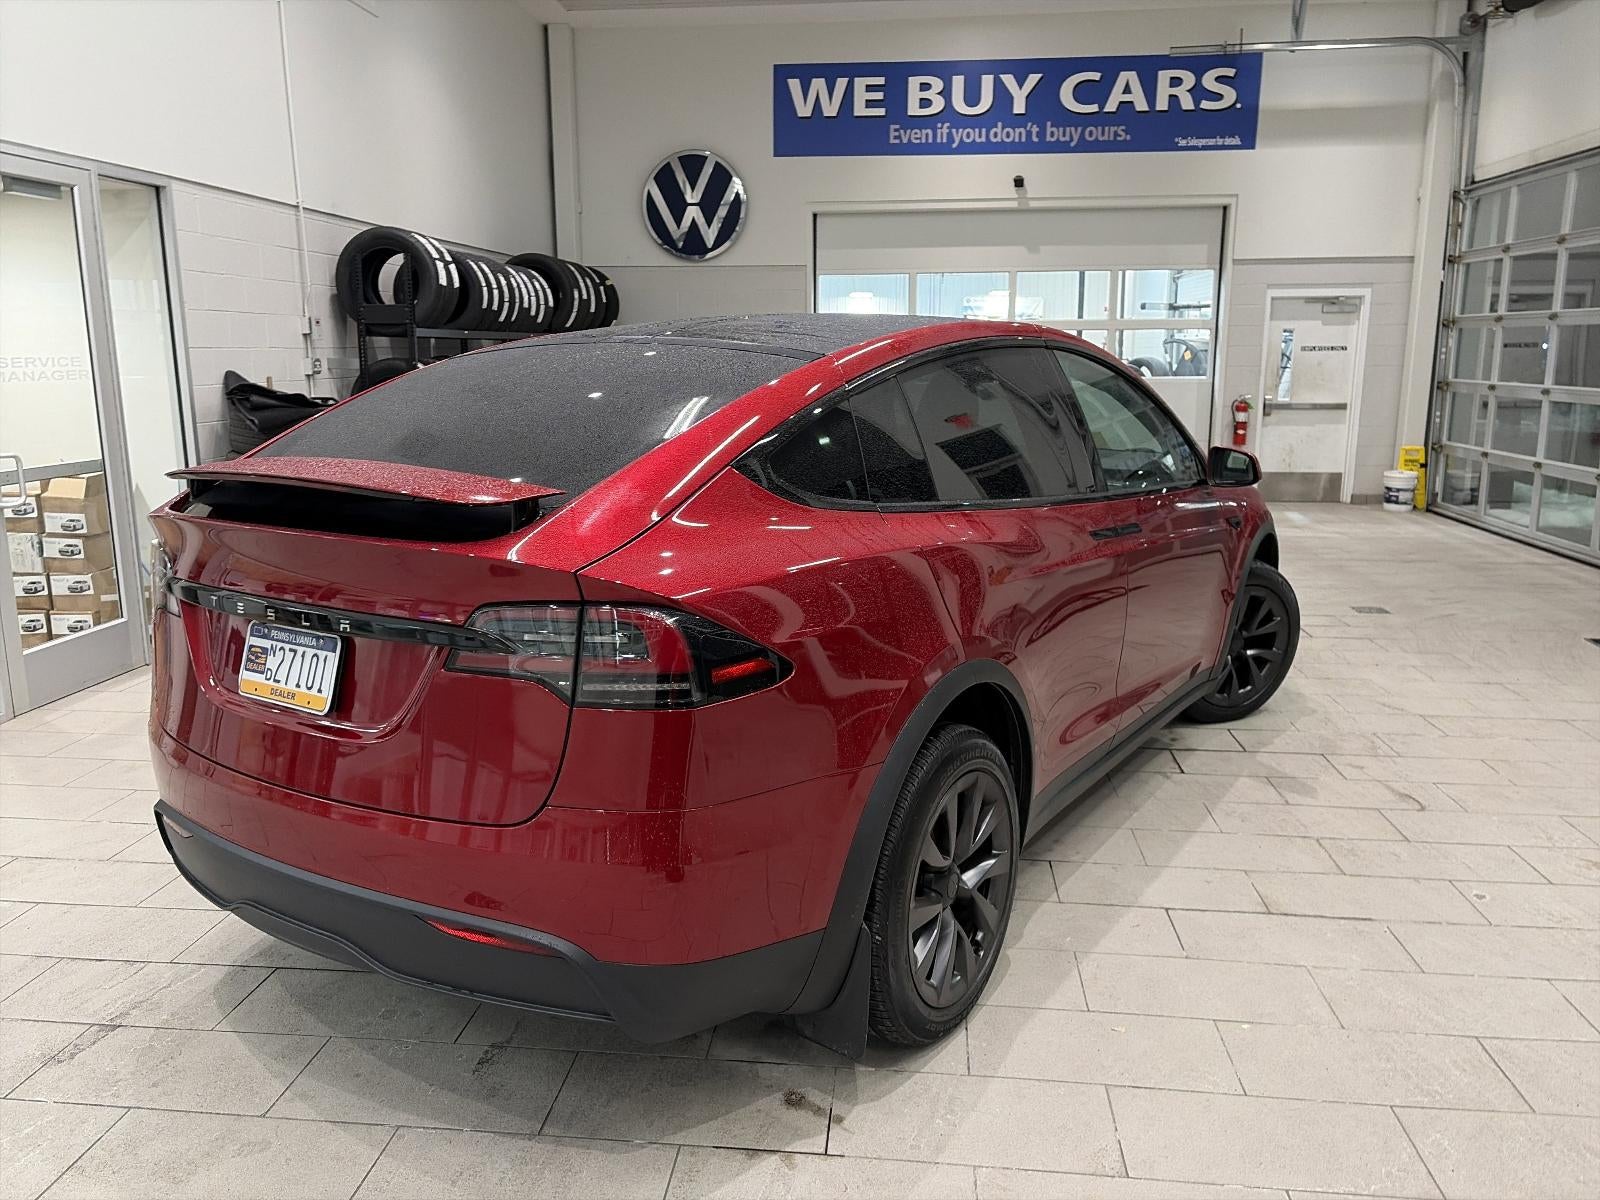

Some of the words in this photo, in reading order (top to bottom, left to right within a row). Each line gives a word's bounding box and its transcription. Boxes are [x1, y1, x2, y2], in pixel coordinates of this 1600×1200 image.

[787, 77, 886, 117] WE
[907, 74, 1043, 117] BUY
[1059, 67, 1242, 114] CARS.
[889, 125, 933, 144] Even
[936, 122, 951, 143] if
[952, 128, 986, 148] you
[989, 121, 1040, 143] don't
[1045, 121, 1085, 147] buy
[1086, 123, 1131, 141] ours.
[0, 356, 81, 370] SERVICE
[270, 629, 317, 647] PENNSYLVANIA
[246, 661, 266, 672] DEALER
[270, 687, 297, 701] DEALER
